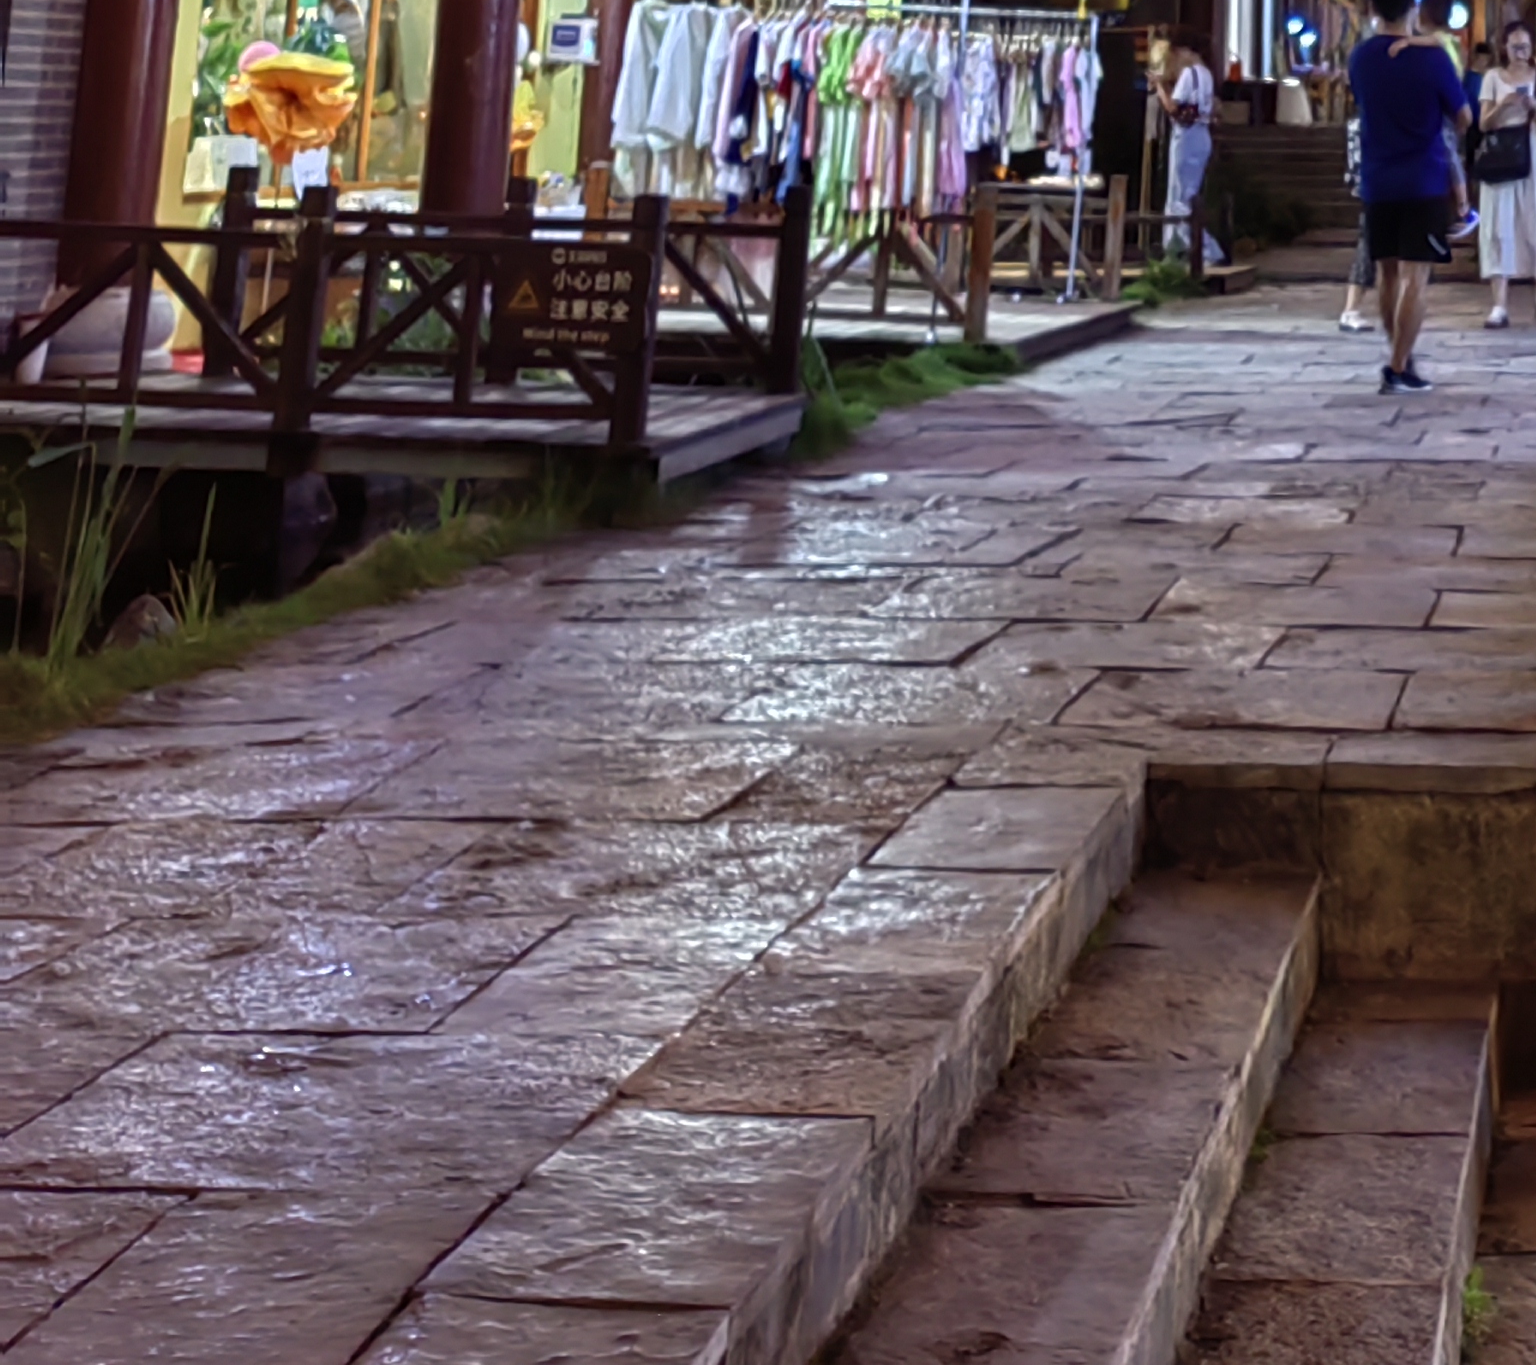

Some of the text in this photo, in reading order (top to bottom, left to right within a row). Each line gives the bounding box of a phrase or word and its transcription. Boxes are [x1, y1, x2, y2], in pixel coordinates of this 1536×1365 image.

[552, 268, 633, 292] 小心台阶
[550, 297, 630, 323] 注意安全
